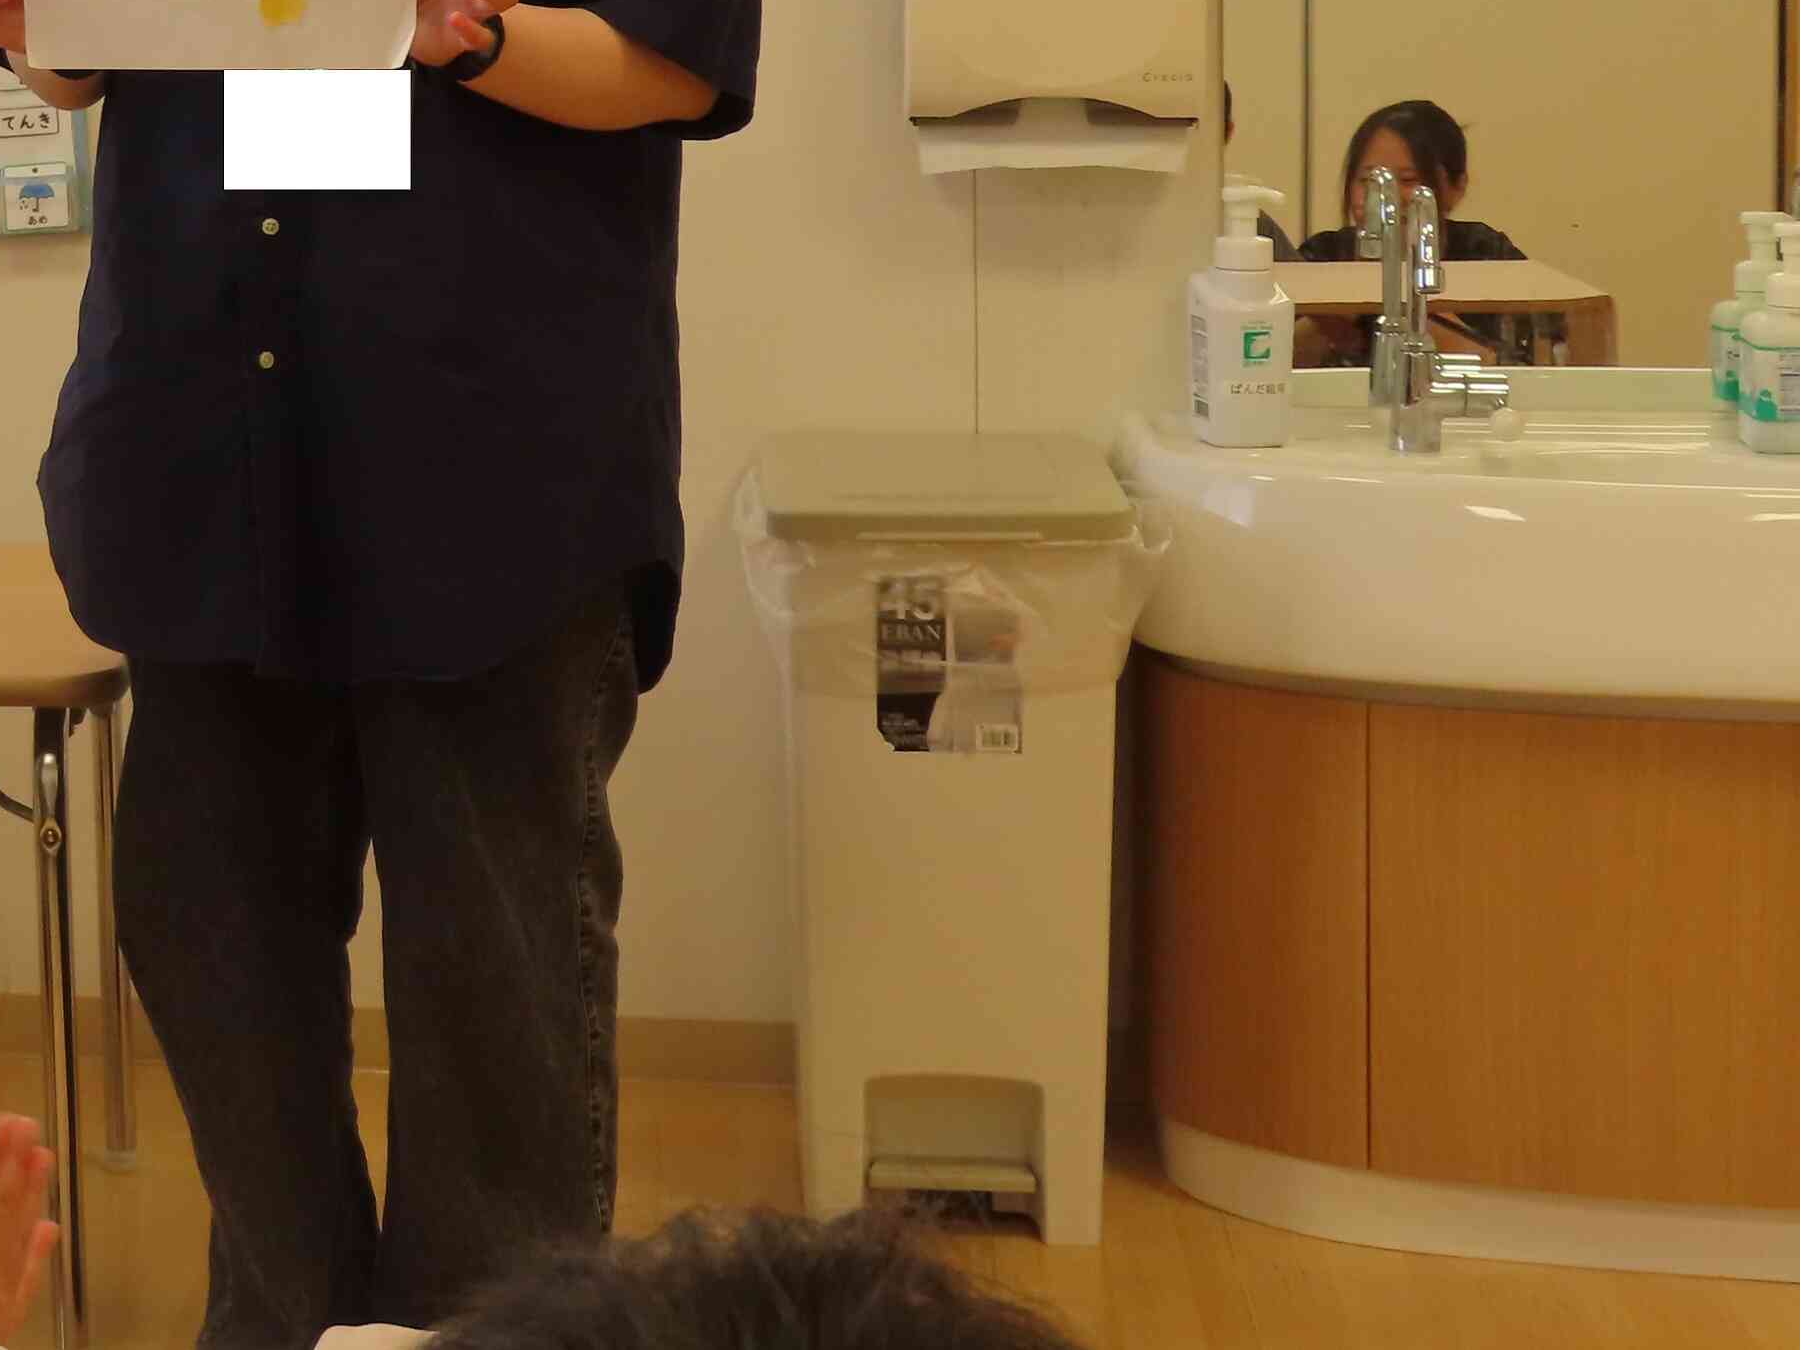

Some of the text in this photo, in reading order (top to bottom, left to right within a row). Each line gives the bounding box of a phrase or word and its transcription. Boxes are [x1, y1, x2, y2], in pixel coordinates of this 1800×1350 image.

[1, 111, 51, 130] てんき
[27, 215, 48, 226] あめ
